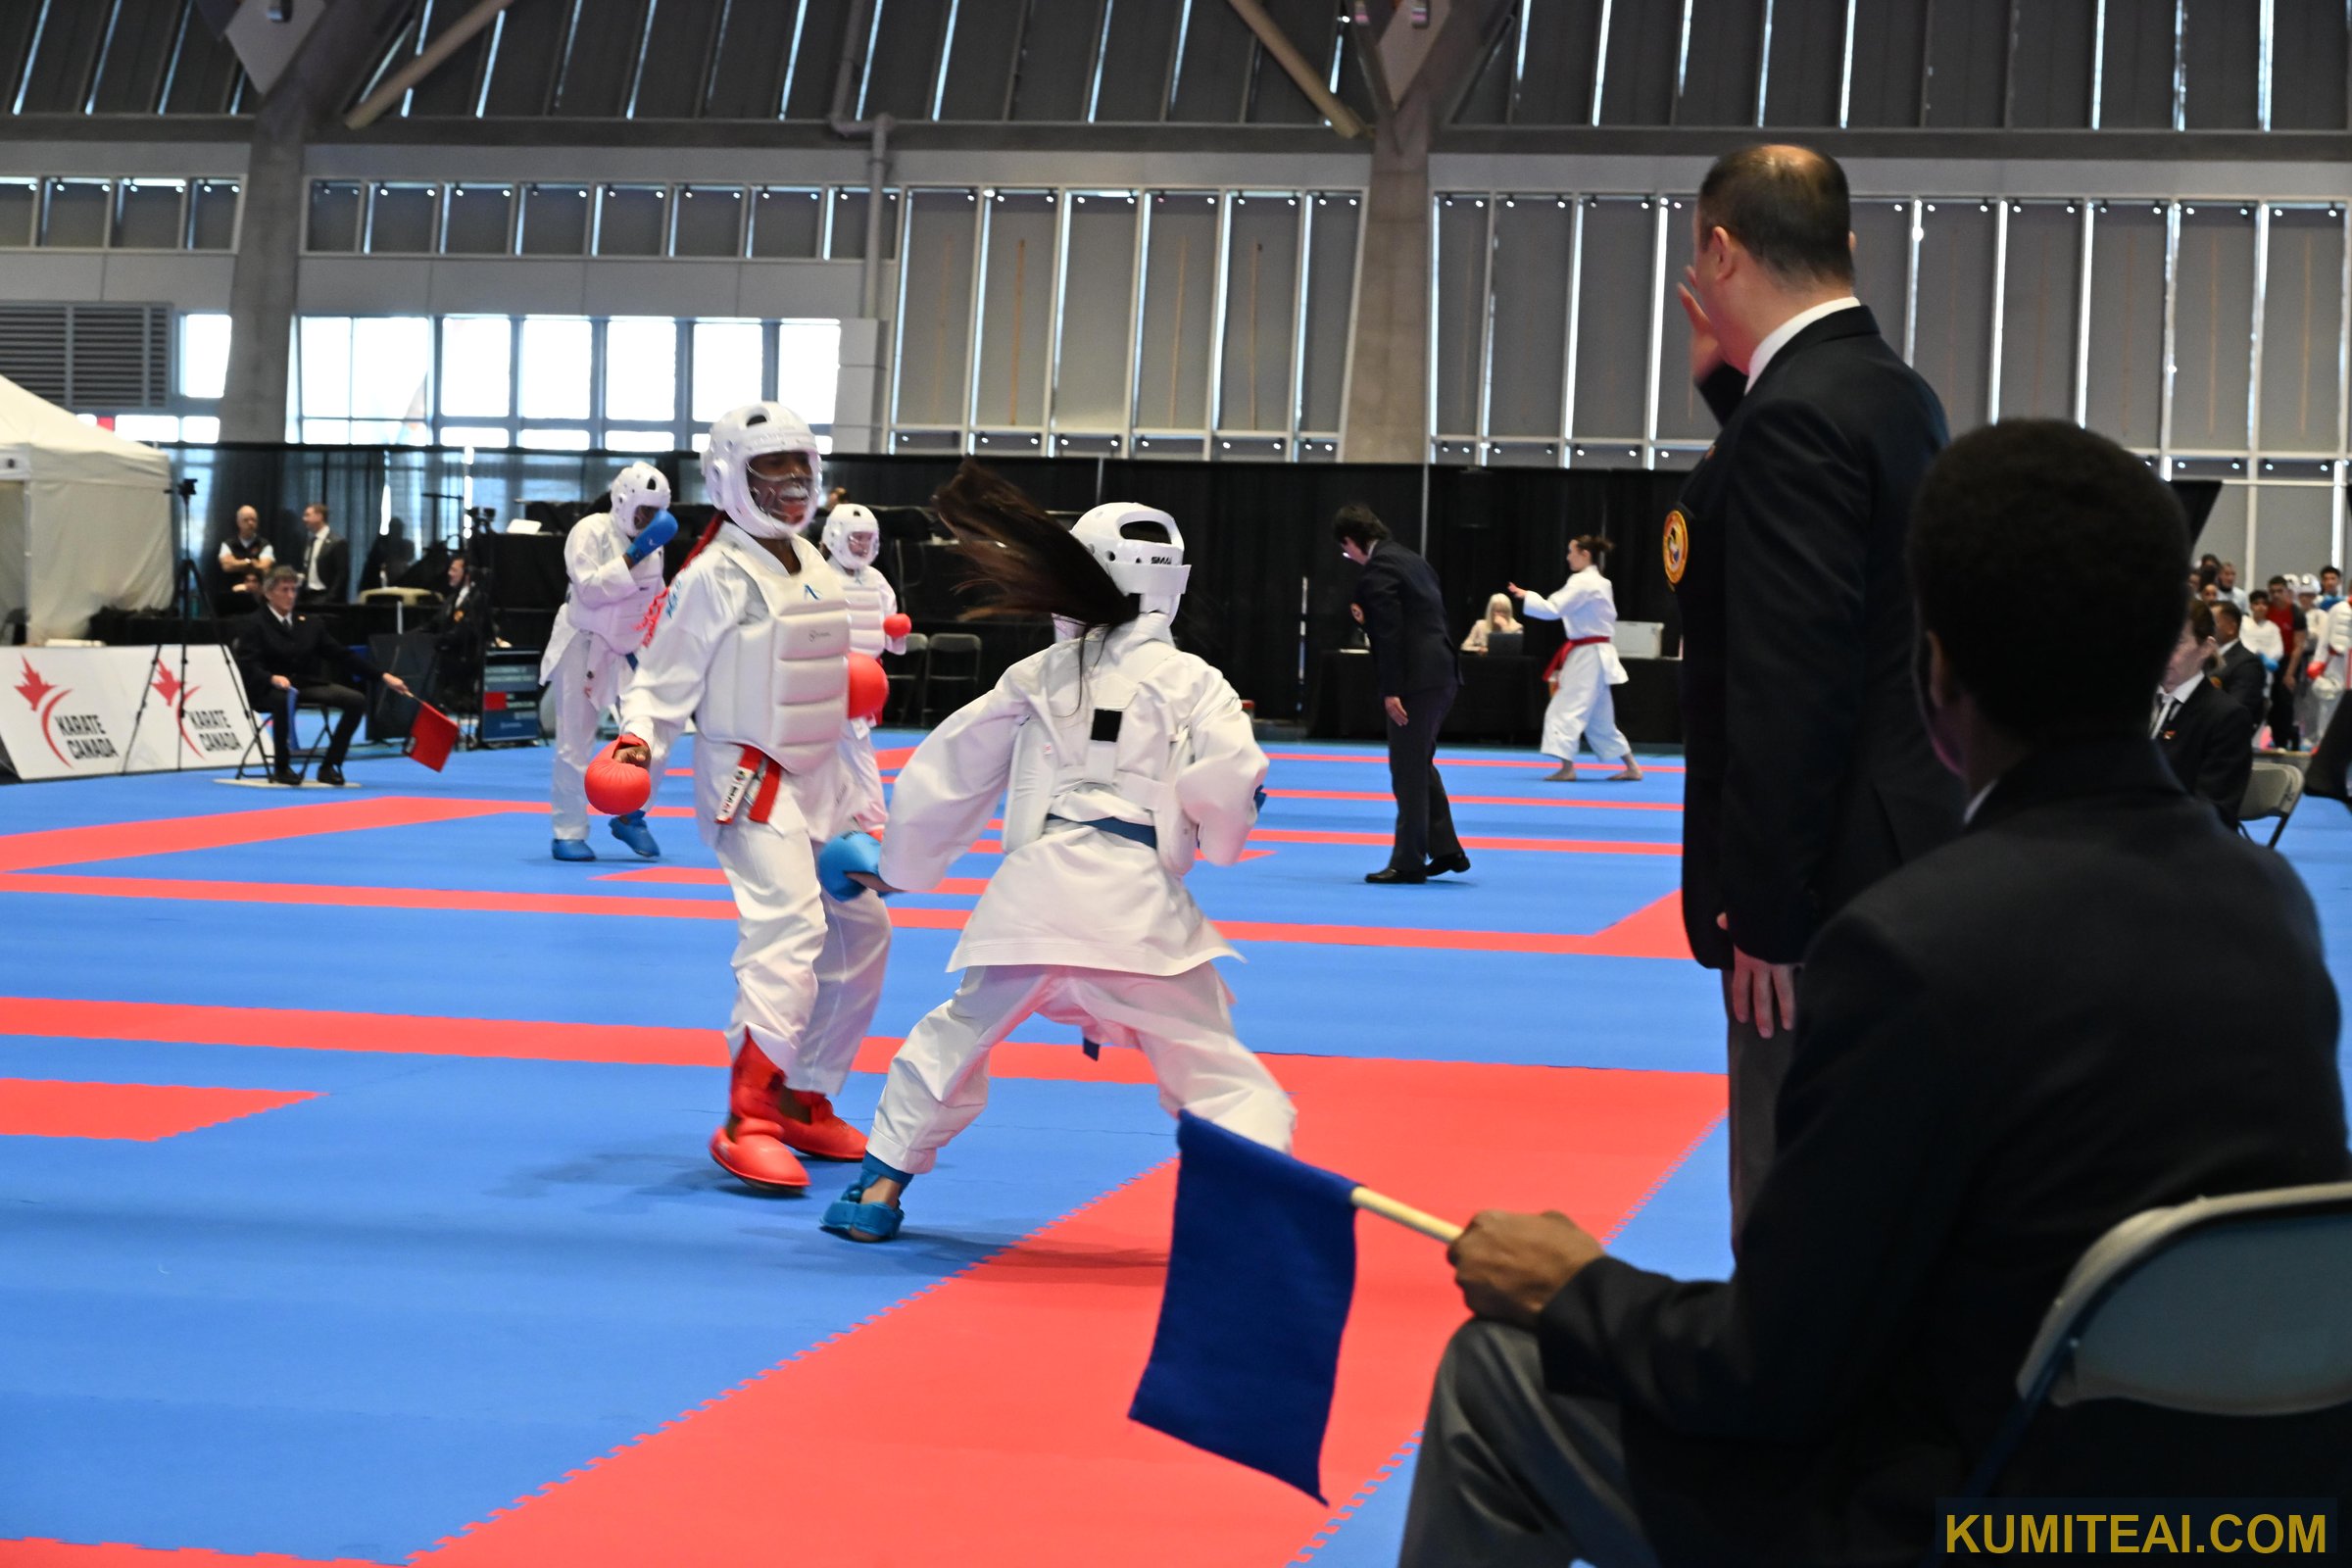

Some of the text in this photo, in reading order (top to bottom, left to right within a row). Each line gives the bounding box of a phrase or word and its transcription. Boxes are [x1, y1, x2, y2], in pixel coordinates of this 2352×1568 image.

[55, 714, 107, 736] KARATE
[186, 710, 231, 730] KARATE
[67, 737, 120, 760] CANADA
[199, 731, 244, 753] CANADA
